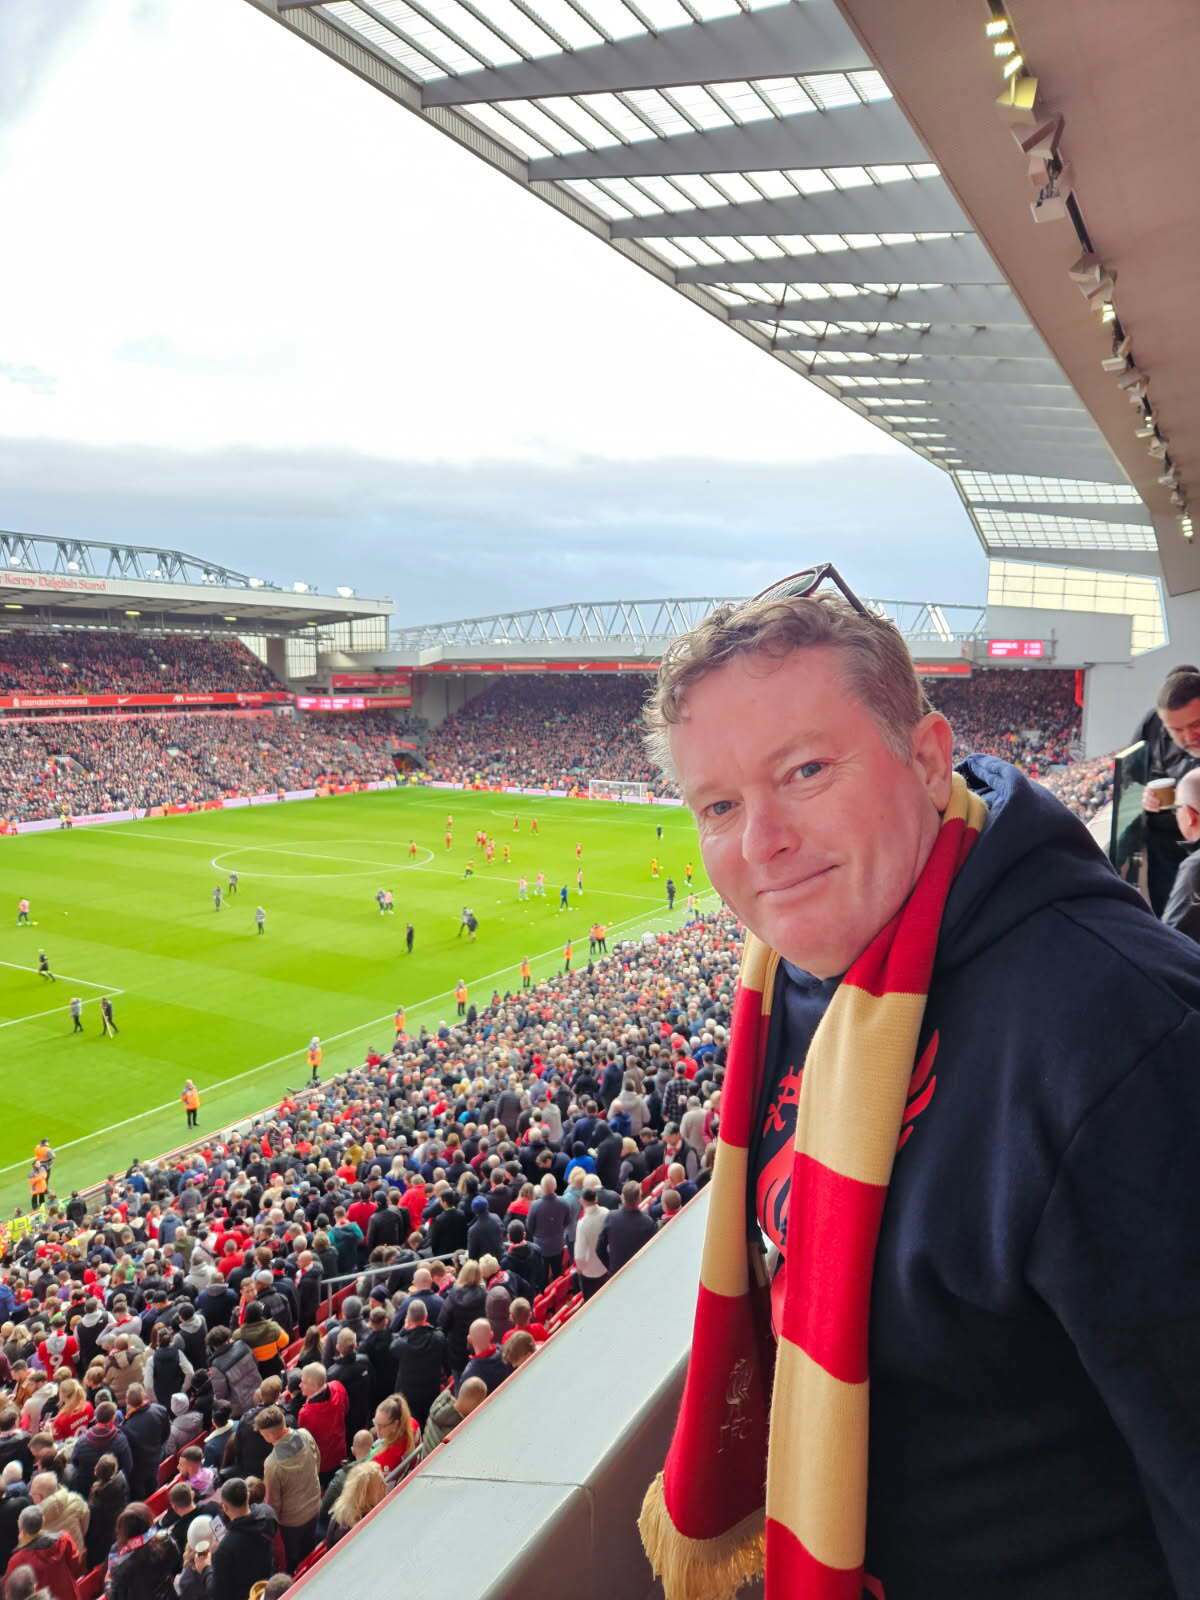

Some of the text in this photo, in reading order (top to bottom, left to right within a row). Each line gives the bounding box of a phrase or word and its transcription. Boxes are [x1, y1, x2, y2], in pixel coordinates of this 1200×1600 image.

[5, 573, 36, 587] Kenny
[79, 579, 106, 591] Stand
[49, 1354, 64, 1372] 9
